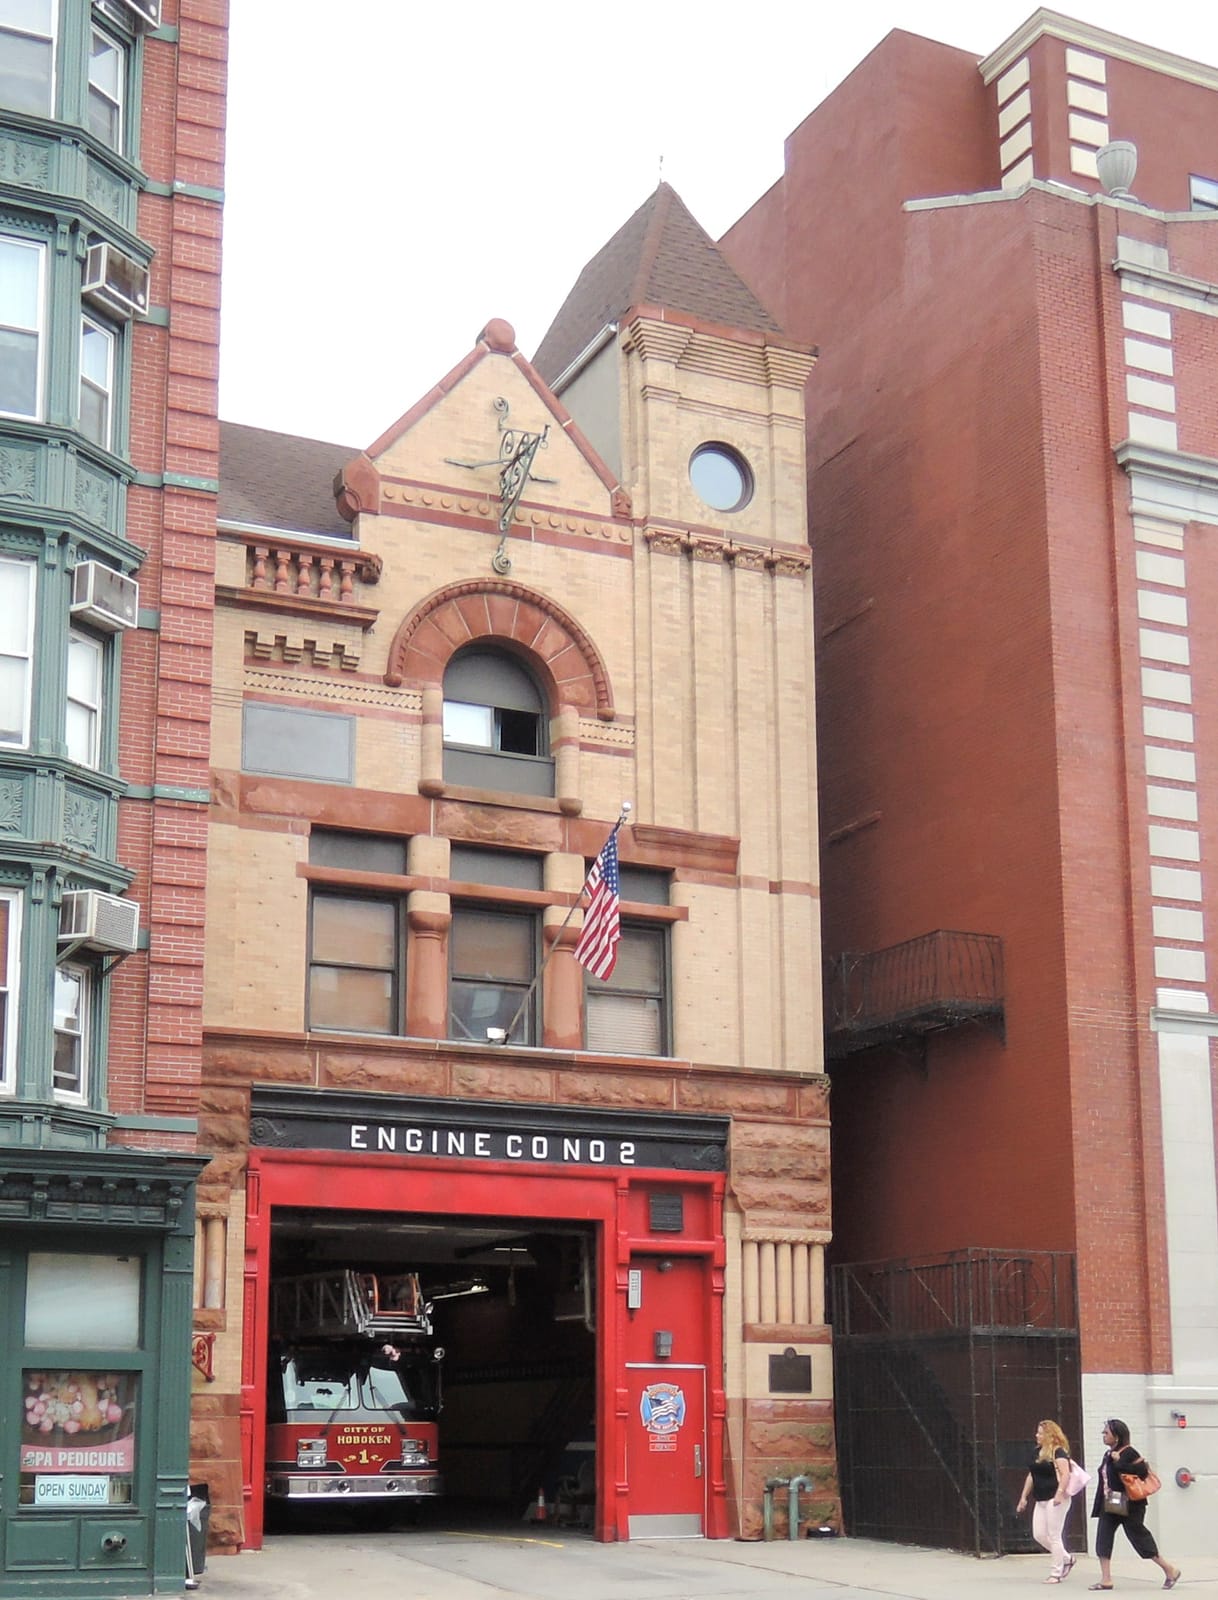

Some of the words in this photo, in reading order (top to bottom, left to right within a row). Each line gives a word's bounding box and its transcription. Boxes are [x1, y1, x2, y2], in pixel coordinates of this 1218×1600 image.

[351, 1125, 491, 1156] ENGINE
[507, 1135, 548, 1159] CO
[564, 1138, 604, 1162] NO
[619, 1142, 635, 1164] 2
[337, 1435, 391, 1444] HOBOKEN
[58, 1451, 125, 1466] PEDICURE
[359, 1449, 369, 1464] 1
[38, 1484, 64, 1496] OPEN
[68, 1484, 106, 1496] SUNDAY
